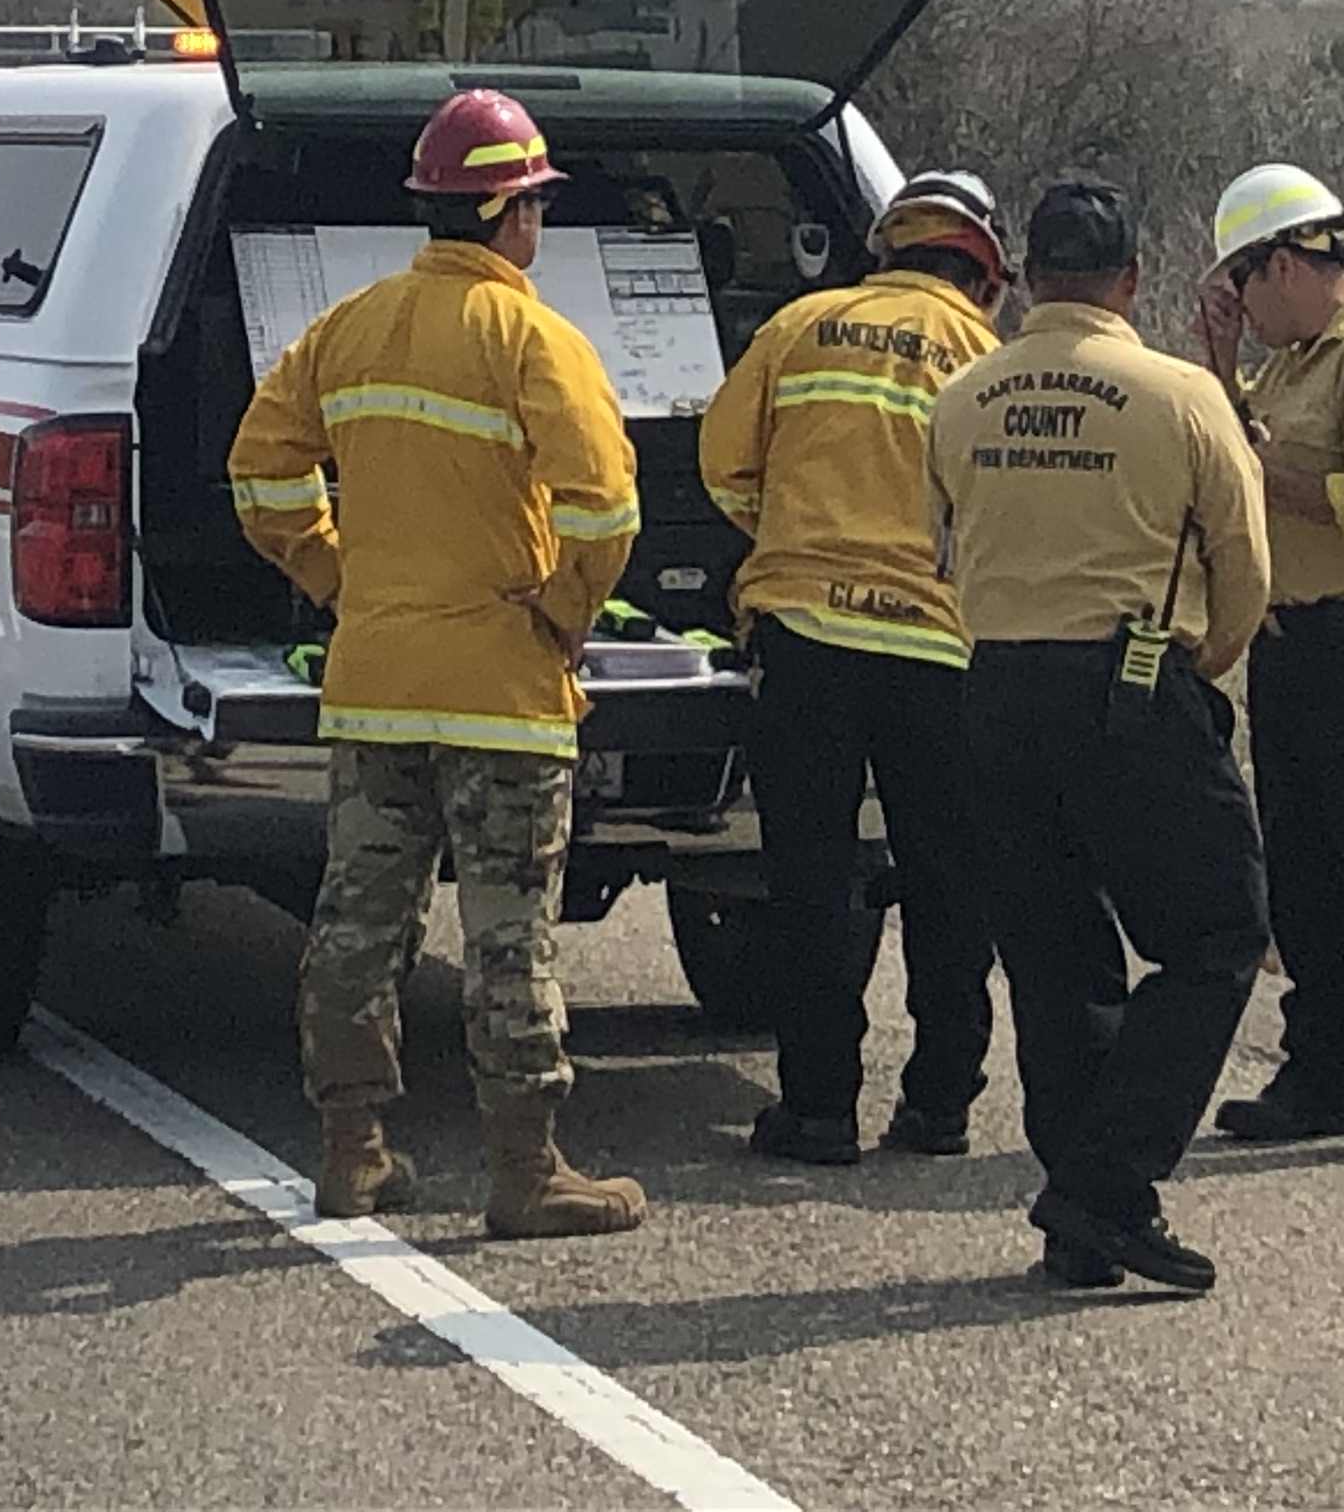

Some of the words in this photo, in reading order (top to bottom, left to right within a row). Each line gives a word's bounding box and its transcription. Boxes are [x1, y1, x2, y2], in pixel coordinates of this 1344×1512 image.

[976, 372, 1036, 409] SANTA
[1040, 371, 1129, 412] BARBARA
[1003, 404, 1086, 438] COUNTY
[1008, 448, 1117, 472] DEPARTMENT
